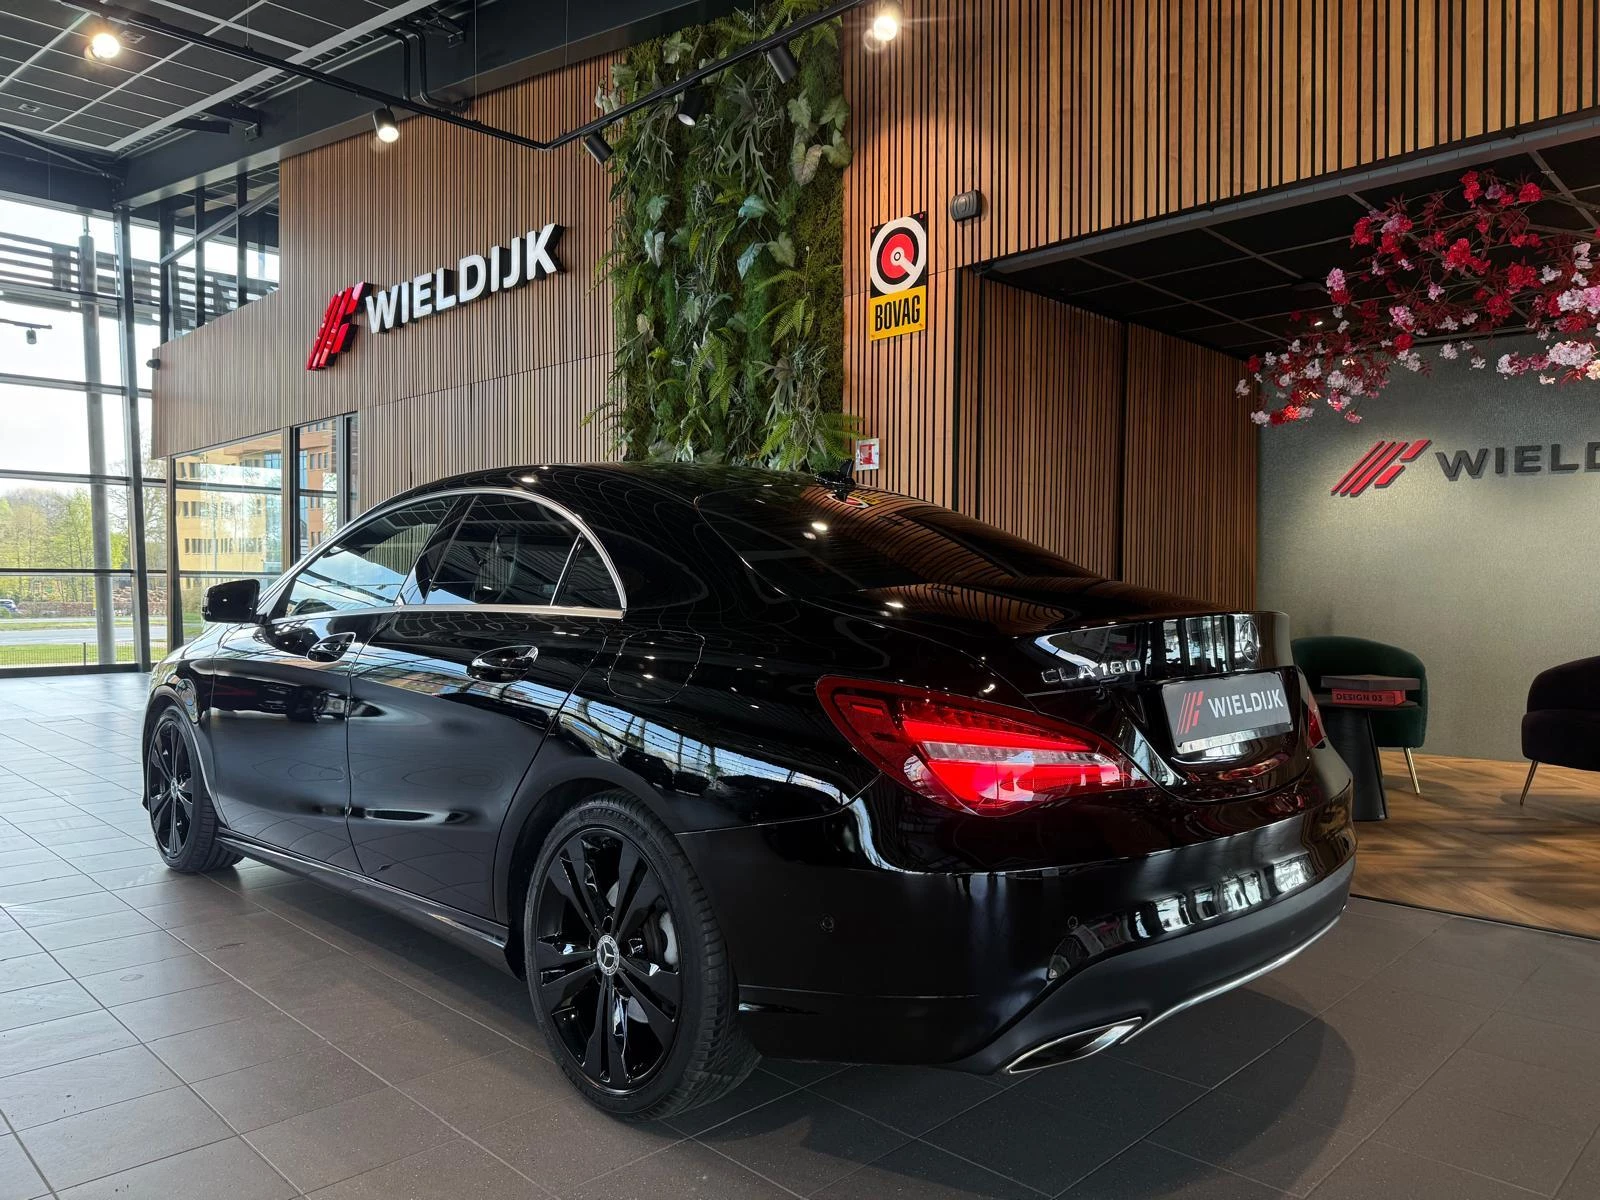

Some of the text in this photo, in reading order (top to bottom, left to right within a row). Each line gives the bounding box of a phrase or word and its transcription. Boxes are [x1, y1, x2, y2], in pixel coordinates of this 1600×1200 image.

[365, 222, 559, 334] WIELDIJK
[875, 294, 921, 332] BOVAG
[1041, 659, 1141, 683] CLA 180
[1207, 688, 1285, 719] WIELDIJK
[1336, 692, 1384, 702] DESIGN 03
